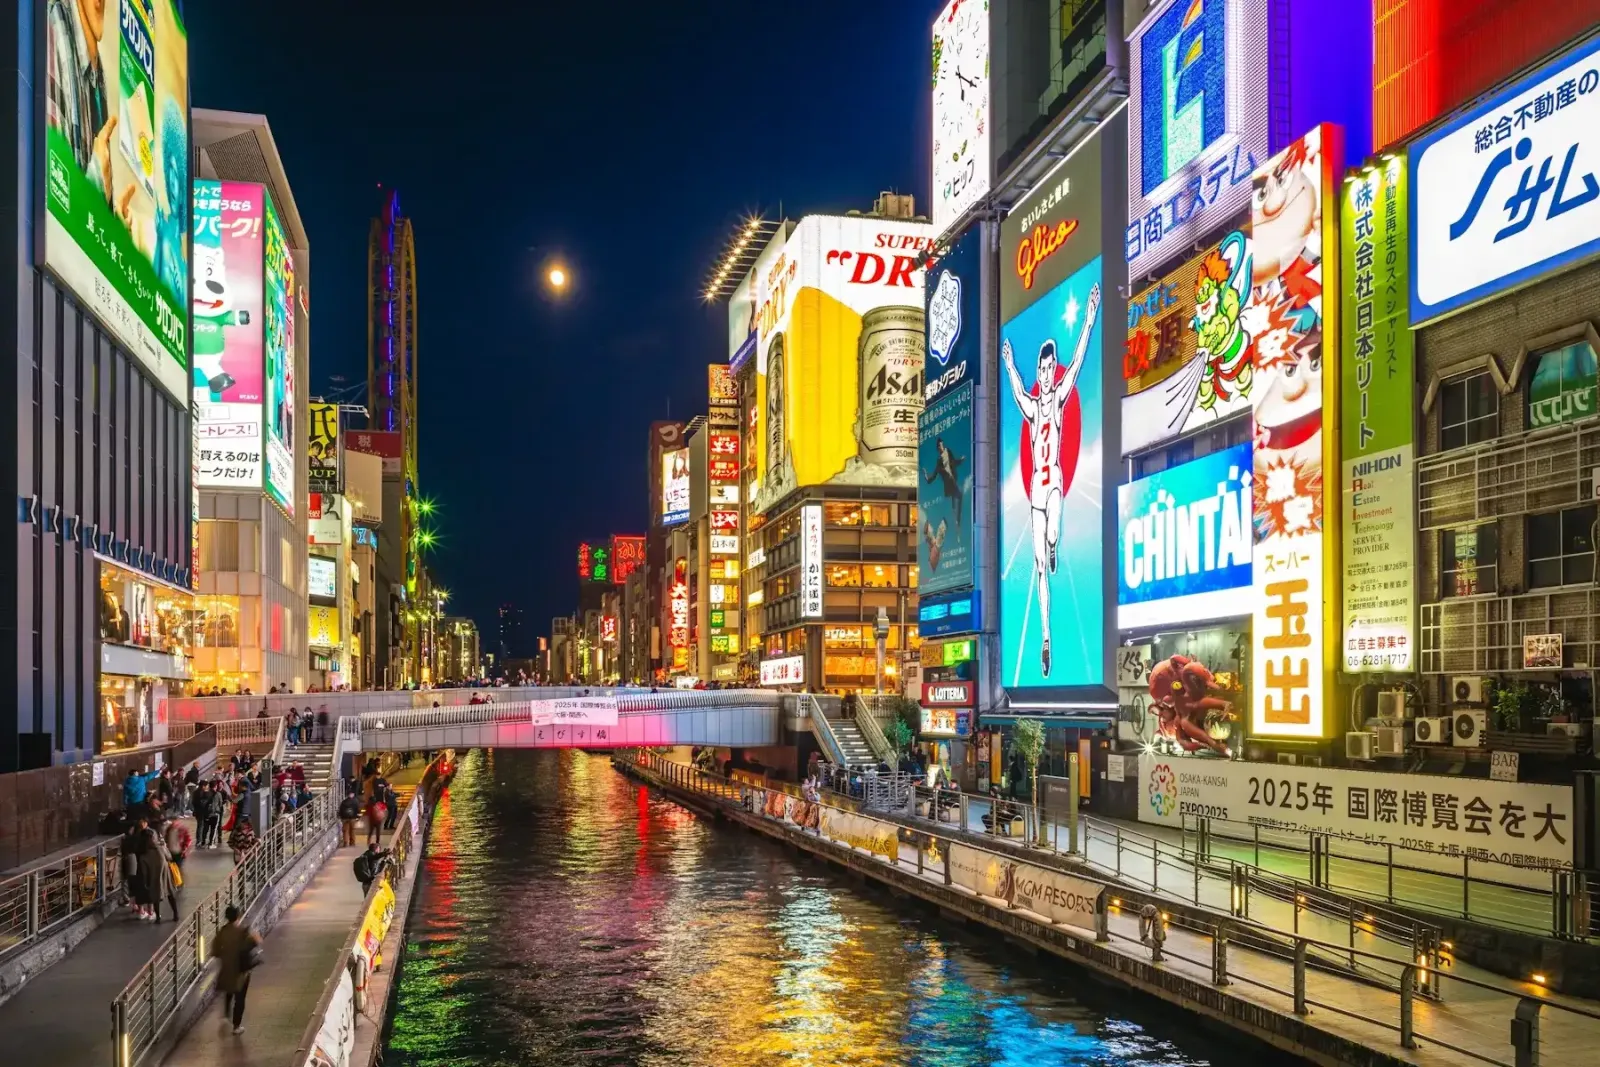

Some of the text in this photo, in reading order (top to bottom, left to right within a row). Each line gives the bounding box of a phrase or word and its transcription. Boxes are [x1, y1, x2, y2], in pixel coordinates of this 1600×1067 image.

[1474, 69, 1599, 154] 総合不動産の
[1021, 178, 1070, 233] おいしさと健康
[1126, 145, 1257, 263] 日商エステム
[193, 215, 262, 238] パーク!
[1017, 219, 1079, 290] Glico
[1385, 168, 1397, 380] 不動産再生のスペシャリスト
[1355, 181, 1375, 450] 株式会社日本リート
[894, 409, 916, 424] 生
[200, 449, 260, 463] 買えるのは
[895, 450, 914, 458] 350ml
[1039, 416, 1053, 486] グリコ
[1352, 454, 1402, 477] NIHON
[1352, 479, 1374, 492] Real
[1352, 493, 1380, 507] Estate
[1352, 506, 1393, 520] Investment
[1352, 520, 1395, 535] Technology
[1352, 533, 1384, 546] SERVICE
[1352, 543, 1390, 556] PROVIDER
[1348, 635, 1407, 651] 広告主募集中
[1263, 578, 1312, 725] 玉出
[1348, 654, 1408, 667] 06-6281-1717
[935, 687, 965, 700] LOTTERIA
[1491, 753, 1517, 768] BAR
[1179, 772, 1229, 788] OSAKA-KANSAI
[1179, 786, 1200, 798] JAPAN
[1248, 776, 1567, 846] 2025年 国際博覧会を大
[1014, 875, 1095, 915] MGM RESORTS
